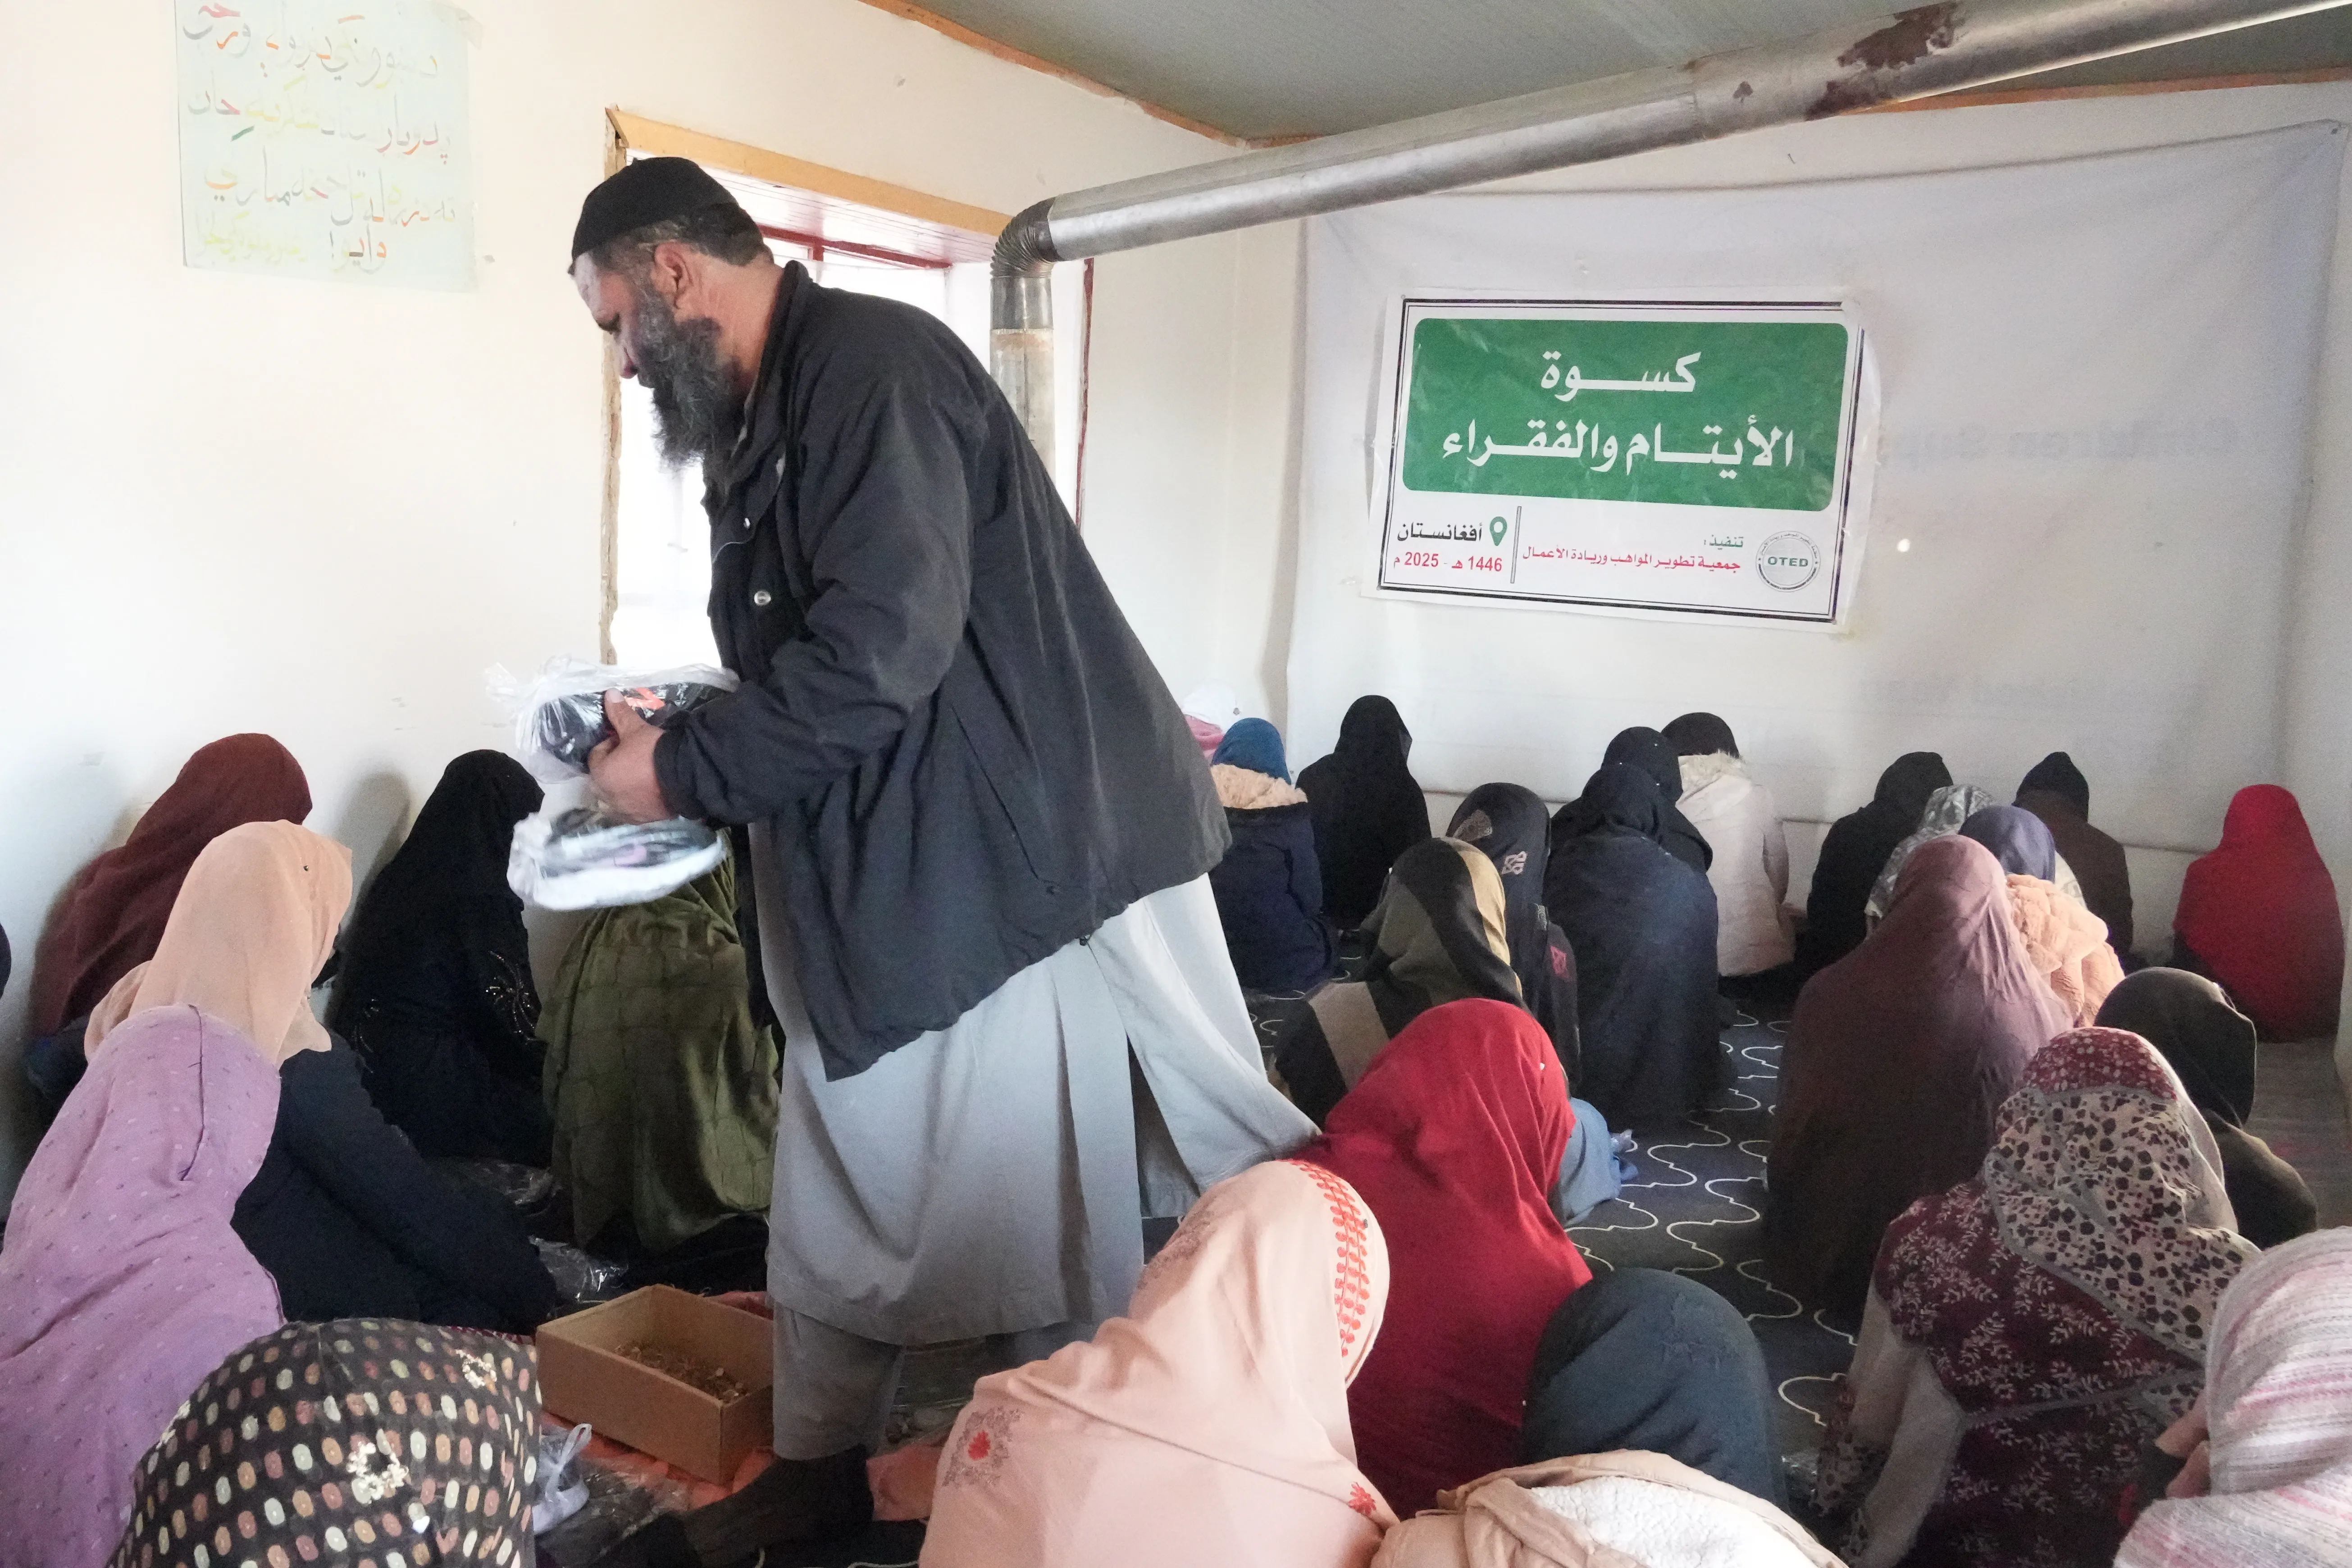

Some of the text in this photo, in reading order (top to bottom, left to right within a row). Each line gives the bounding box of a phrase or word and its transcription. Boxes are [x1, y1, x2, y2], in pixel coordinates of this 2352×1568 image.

[1541, 350, 1702, 402] كسوة
[1442, 414, 1794, 480] الأيتام والفقراء
[1397, 521, 1483, 542] أفغانستان
[1404, 551, 1439, 568] 2025
[1468, 555, 1503, 572] 1446
[1571, 549, 1608, 565] وريادة
[1610, 553, 1652, 567] المواهب
[1653, 554, 1695, 569] تطوير
[1698, 556, 1741, 573] جمعية
[1767, 556, 1809, 568] OTED
